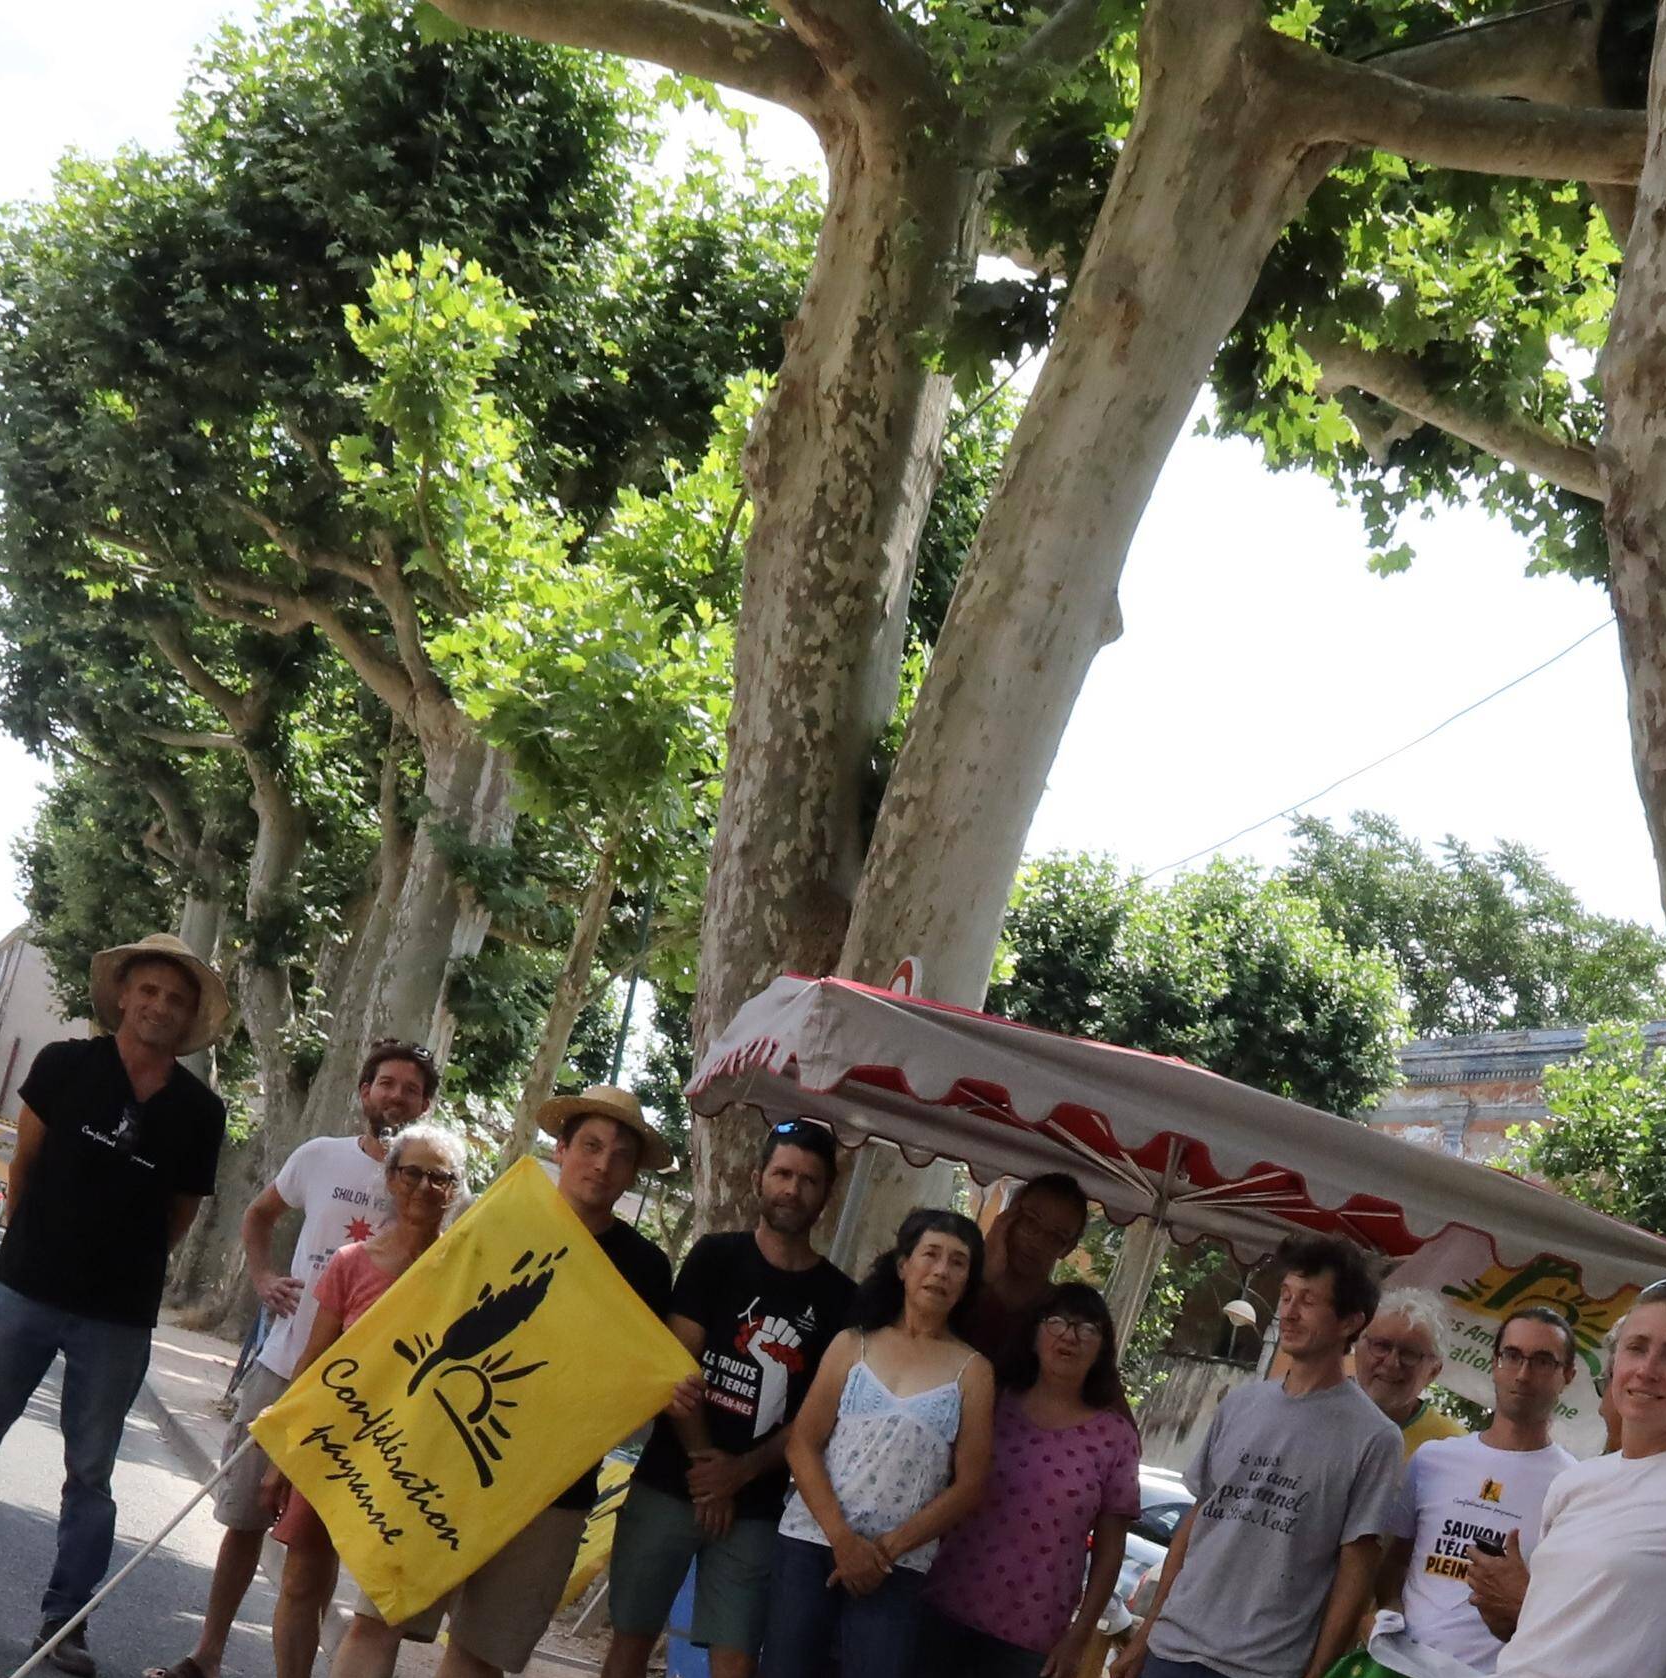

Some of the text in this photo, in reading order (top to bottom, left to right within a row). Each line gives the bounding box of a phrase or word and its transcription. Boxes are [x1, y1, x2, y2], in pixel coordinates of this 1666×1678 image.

[721, 1375, 757, 1399] TERRE
[321, 1358, 460, 1551] Confédération
[299, 1425, 403, 1545] paysanne
[1203, 1500, 1225, 1520] du
[1442, 1519, 1507, 1543] SAUVON
[1425, 1555, 1469, 1579] PLEIN
